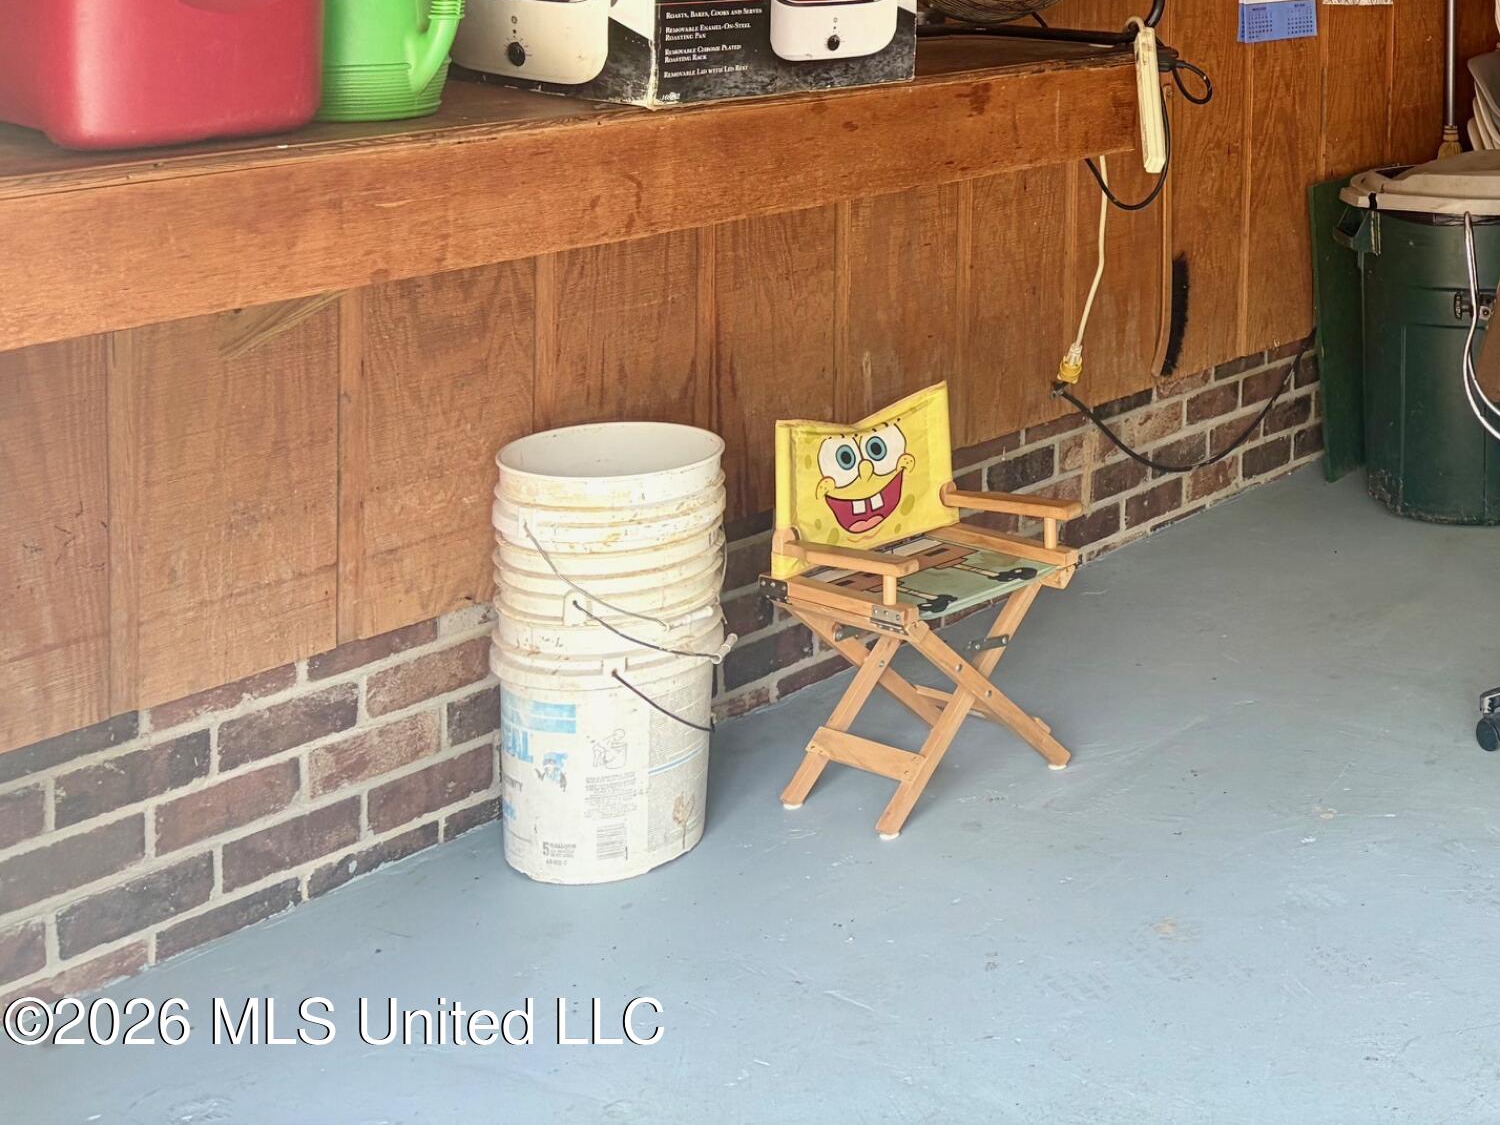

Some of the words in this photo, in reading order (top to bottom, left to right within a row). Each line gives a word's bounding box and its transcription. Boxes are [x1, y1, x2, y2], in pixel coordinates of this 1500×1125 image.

[690, 10, 710, 18] BAKES,
[665, 26, 699, 34] REMOVABLE
[665, 33, 694, 41] ROASTING
[664, 48, 696, 56] REMOVABLE
[664, 56, 691, 64] ROASTING
[663, 70, 696, 78] REMOVABLE
